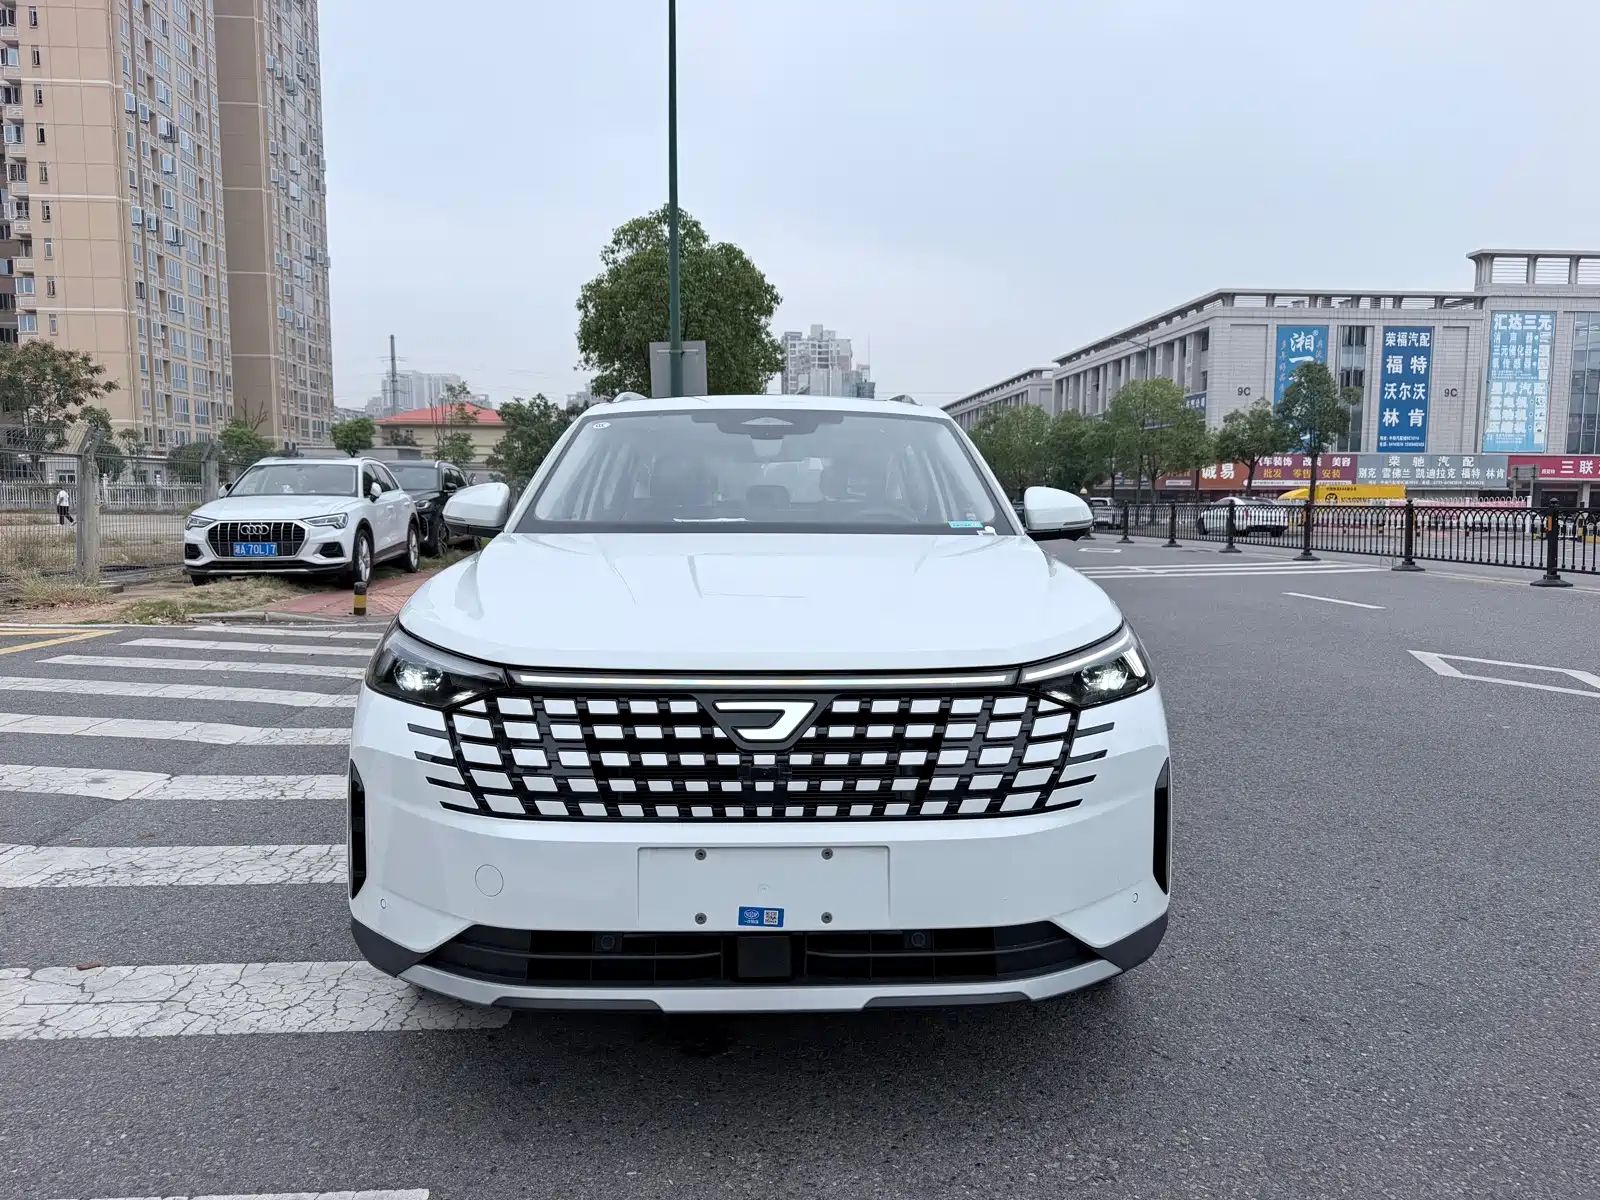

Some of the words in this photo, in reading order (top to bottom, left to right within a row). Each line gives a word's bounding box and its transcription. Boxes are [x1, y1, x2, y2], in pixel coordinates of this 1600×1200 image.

[1493, 313, 1552, 330] 汇达三元
[1385, 331, 1430, 347] 荣福汽配
[1289, 331, 1315, 382] 湘一
[1386, 355, 1427, 374] 福特
[1237, 387, 1251, 396] 9C
[1384, 382, 1426, 400] 沃尔沃
[1444, 388, 1458, 397] 9C
[1382, 408, 1425, 427] 林肯
[1332, 457, 1351, 467] 美容
[1388, 456, 1475, 467] 荣驰汽配
[1560, 460, 1600, 475] 三联
[1201, 463, 1235, 479] 诚易
[1263, 468, 1282, 479] 批发
[1292, 468, 1312, 479] 零售
[1322, 468, 1341, 479] 安装
[1358, 468, 1376, 479] 别克
[1382, 468, 1411, 479] 雪佛兰
[1416, 468, 1456, 479] 凯迪拉克
[1461, 468, 1480, 479] 福特
[1486, 468, 1504, 479] 林肯
